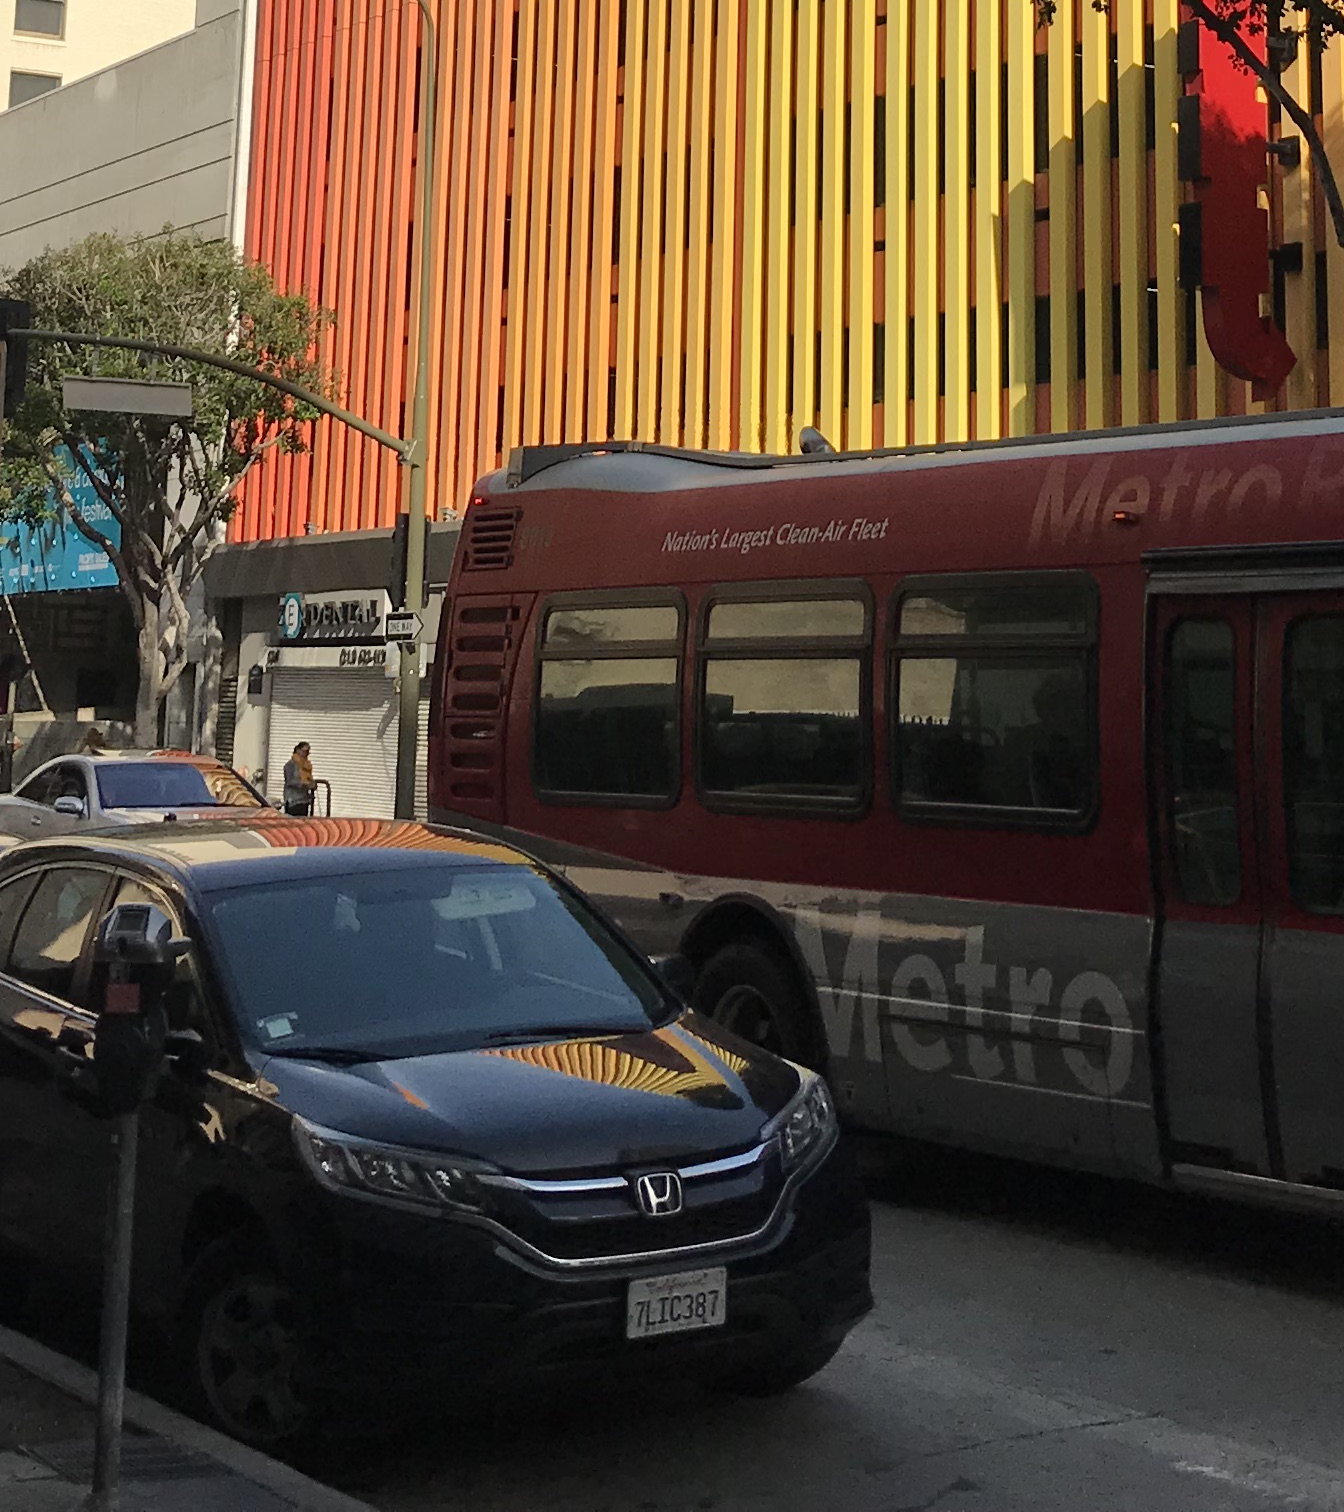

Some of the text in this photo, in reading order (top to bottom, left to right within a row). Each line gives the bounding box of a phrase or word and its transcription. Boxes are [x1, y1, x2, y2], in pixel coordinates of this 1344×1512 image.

[1029, 455, 1283, 550] Metro
[660, 517, 891, 554] Nation's Largest Clean-Air Fleet
[389, 621, 413, 632] ONE WAY
[794, 905, 1134, 1097] Metro
[634, 1289, 720, 1328] 7LIC387
